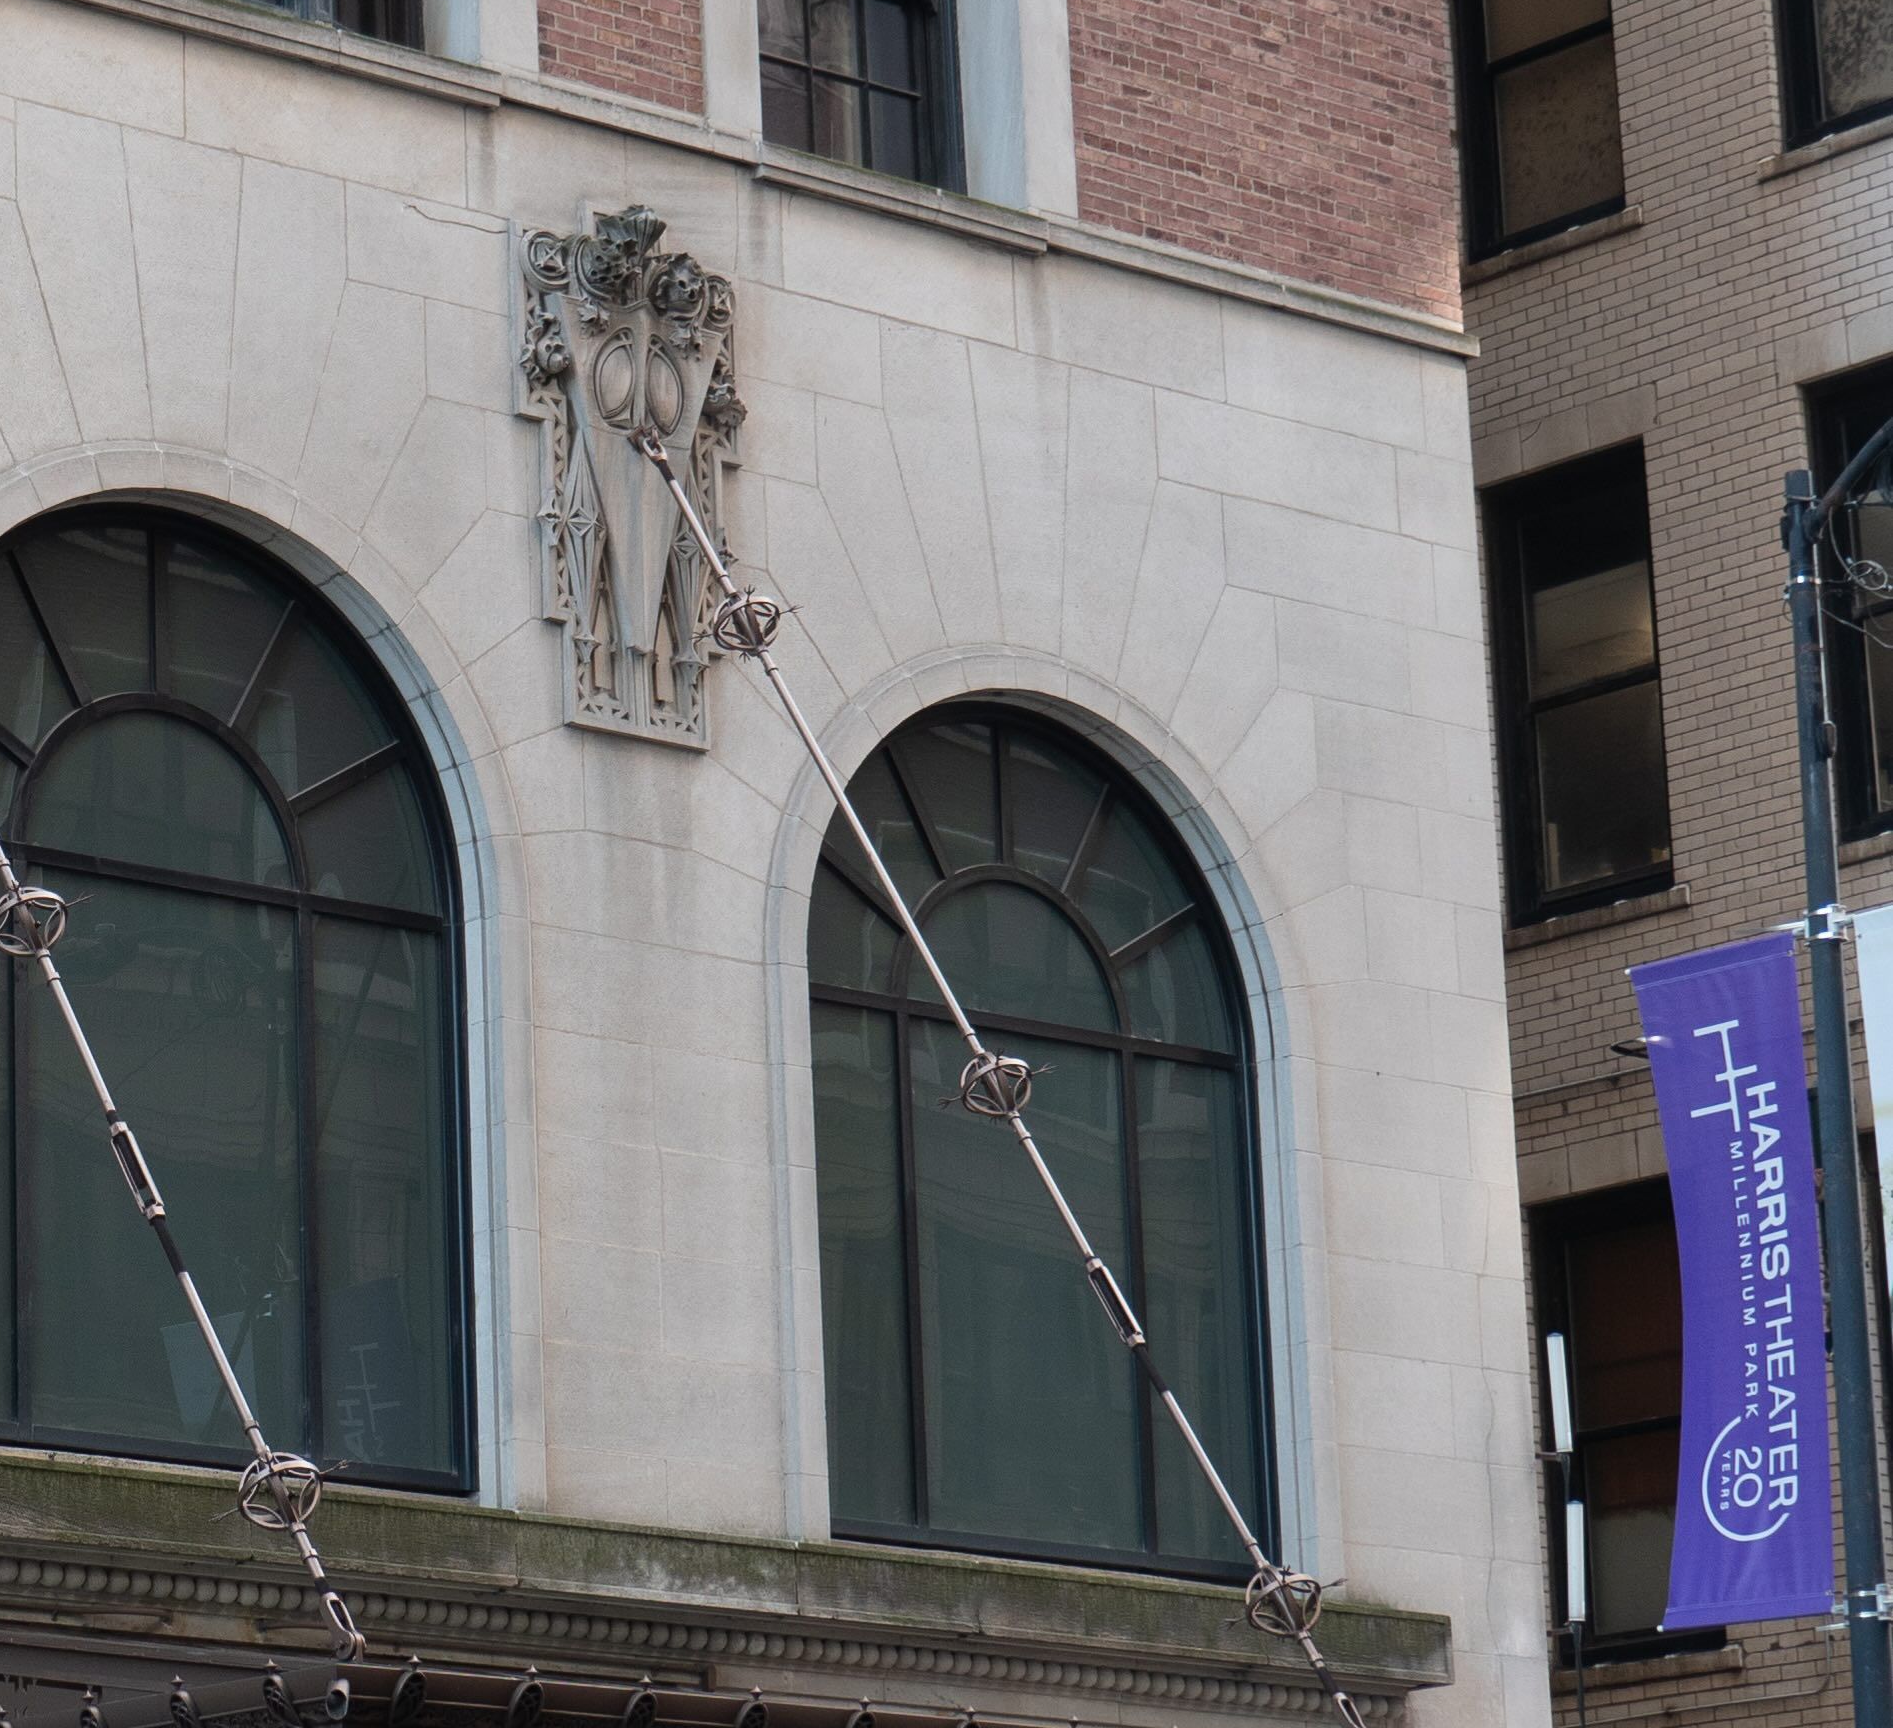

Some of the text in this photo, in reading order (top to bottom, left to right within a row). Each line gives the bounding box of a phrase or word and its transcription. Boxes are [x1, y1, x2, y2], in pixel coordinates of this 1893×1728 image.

[1729, 1140, 1759, 1419] MILLENNIUM PARK
[1745, 1081, 1799, 1511] HARRIS THEATER
[1720, 1450, 1732, 1511] YEARS
[1733, 1446, 1763, 1508] 20
